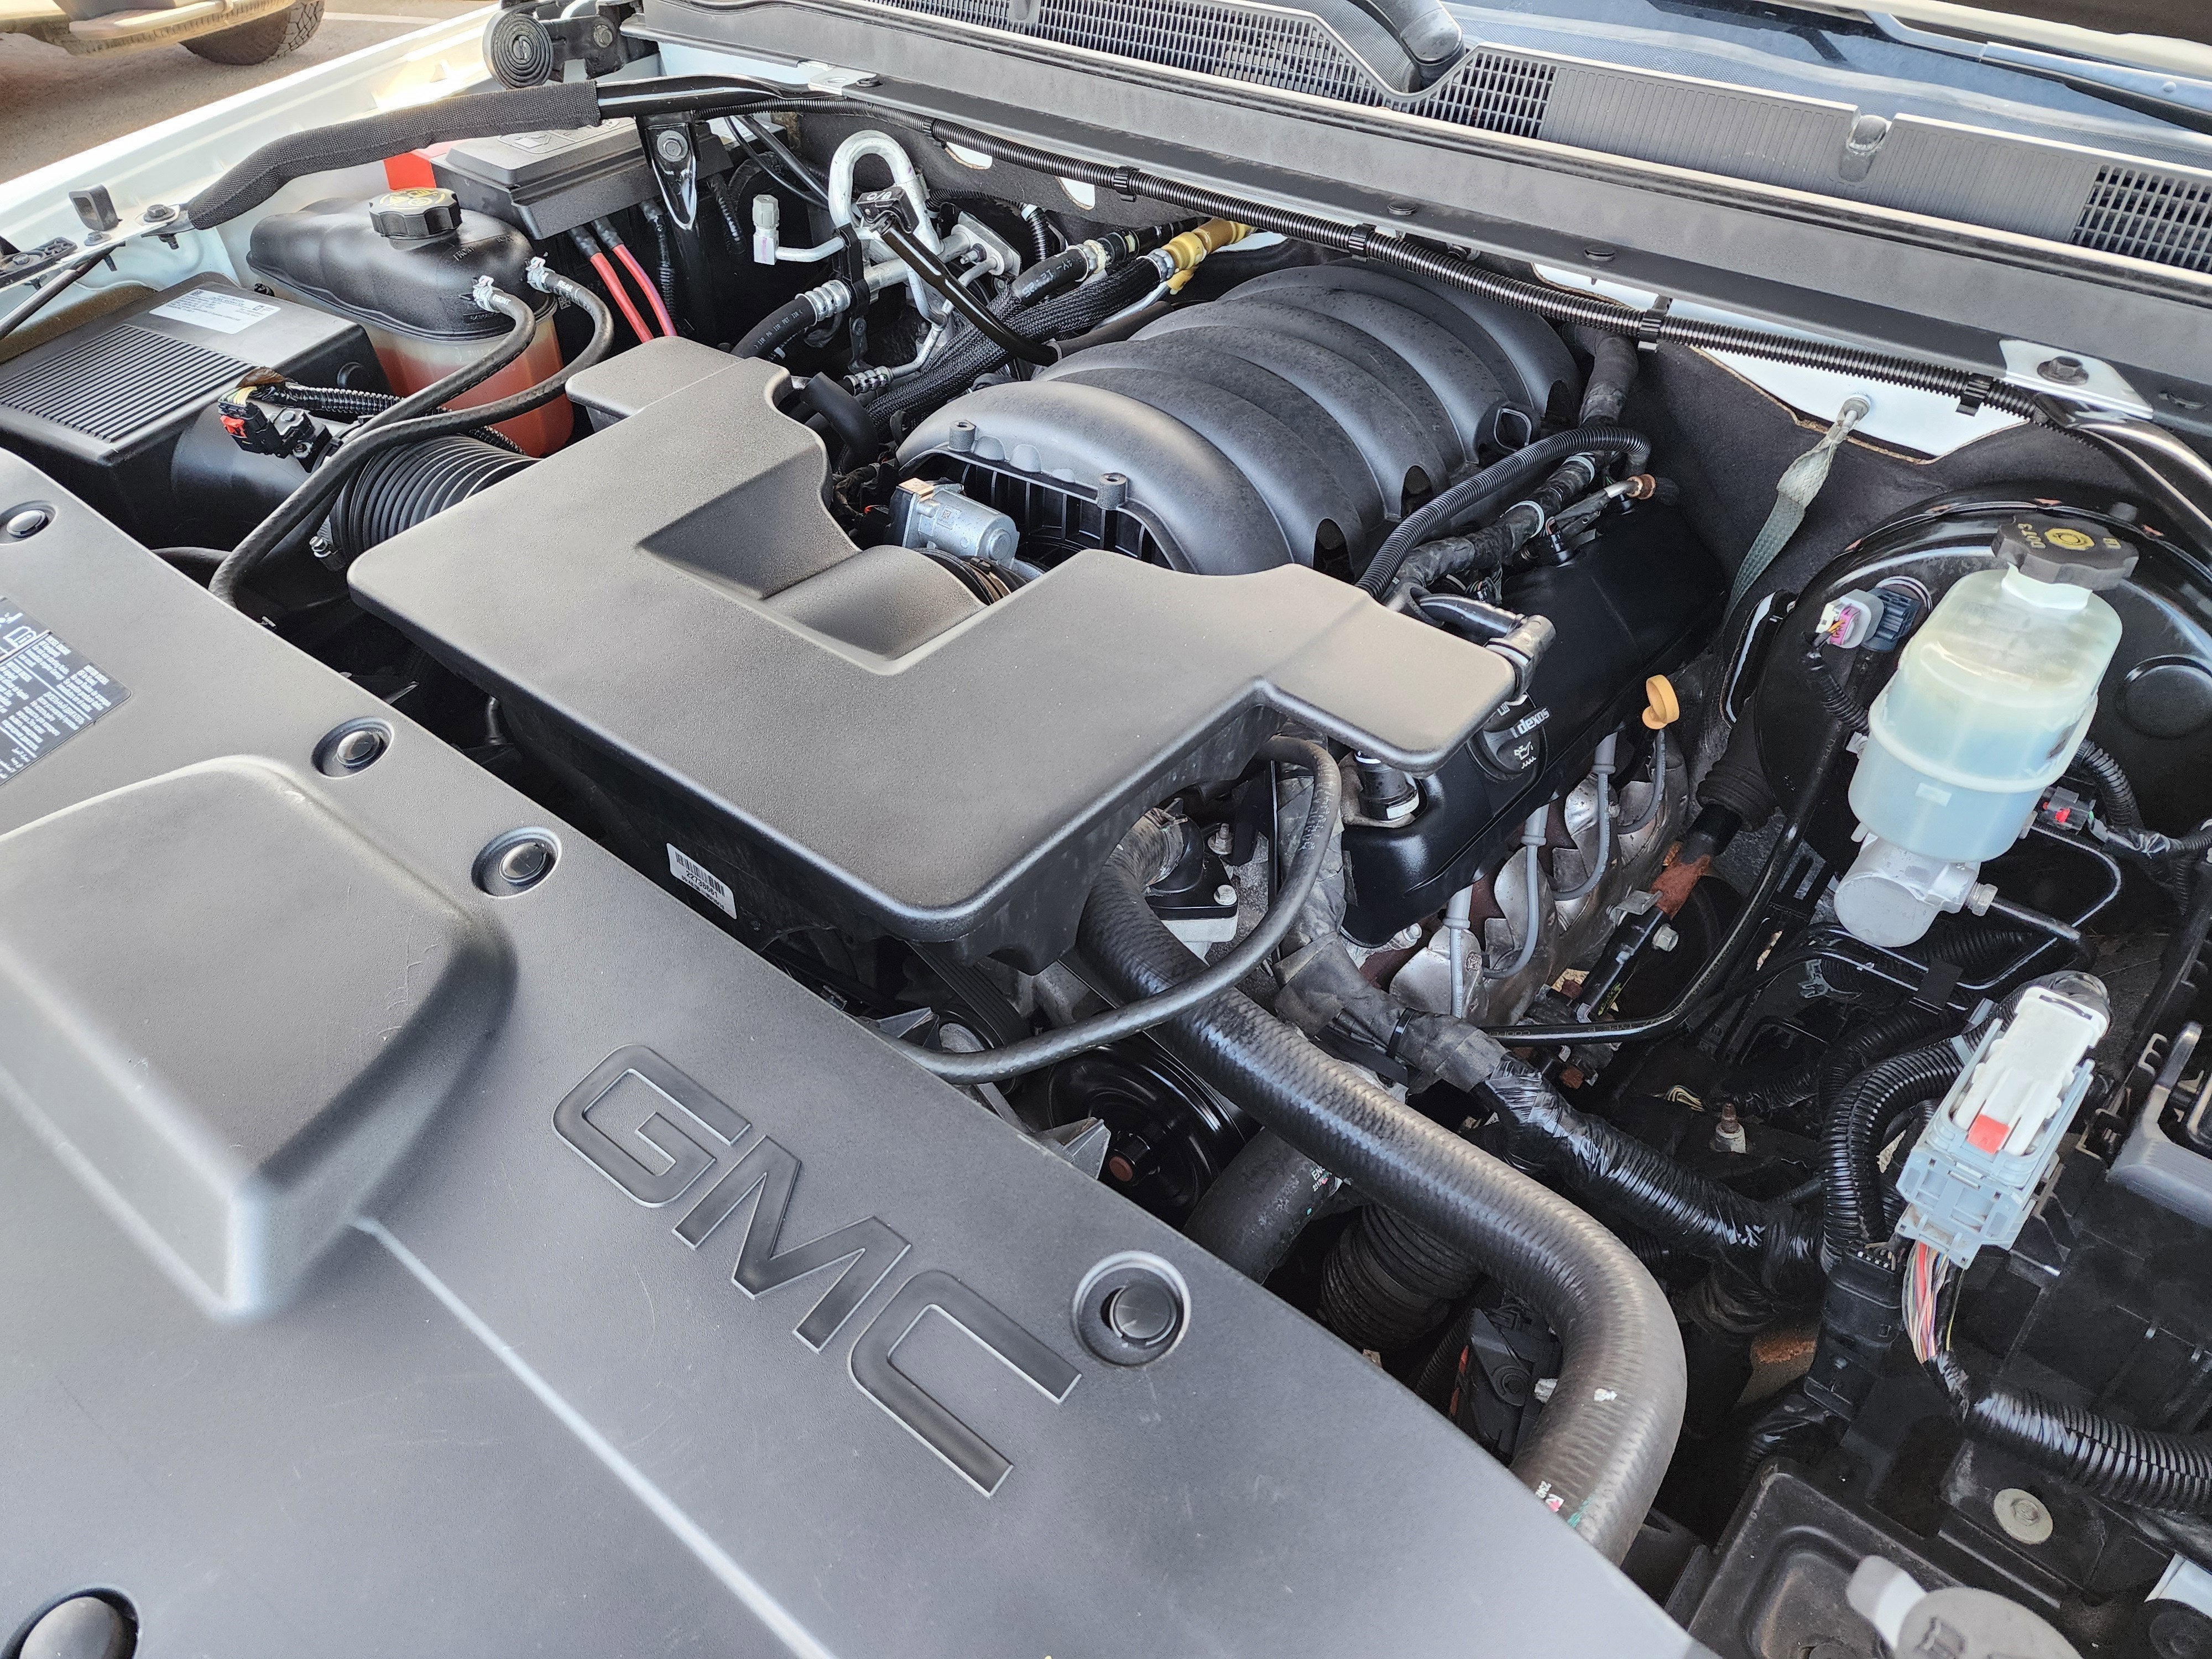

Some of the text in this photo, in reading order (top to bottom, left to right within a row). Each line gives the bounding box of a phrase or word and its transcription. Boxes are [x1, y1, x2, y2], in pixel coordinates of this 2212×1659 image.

[557, 280, 573, 293] REAR
[492, 294, 512, 306] FRONT
[1517, 708, 1550, 734] dexos
[552, 1044, 1083, 1499] GMC
